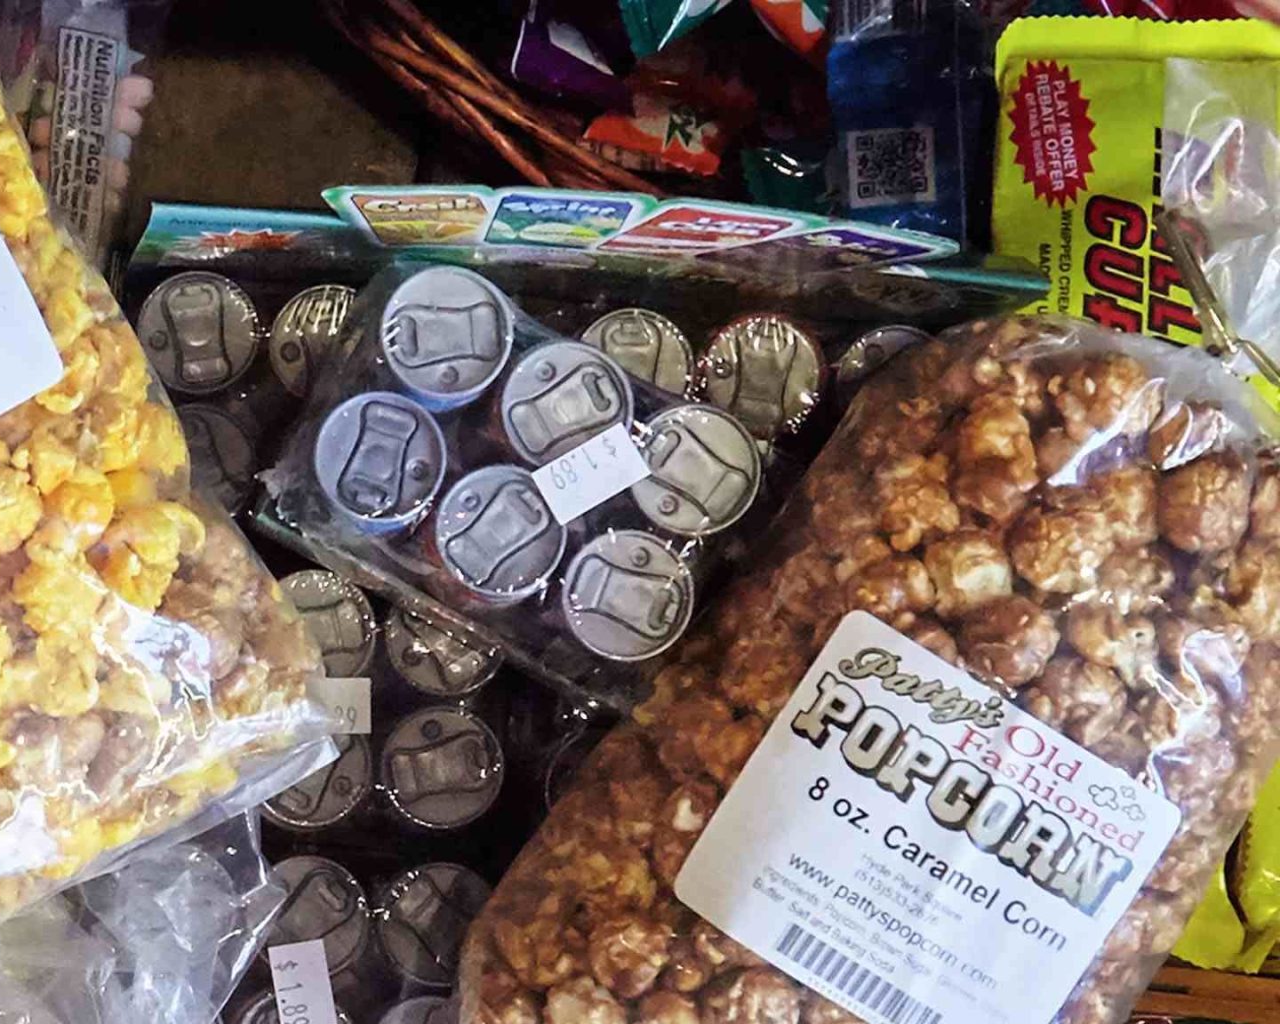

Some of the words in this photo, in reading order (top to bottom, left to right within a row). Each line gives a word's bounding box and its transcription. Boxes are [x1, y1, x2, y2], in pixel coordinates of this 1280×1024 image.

[90, 39, 115, 127] Nutrition
[1052, 79, 1070, 118] PLAY
[85, 131, 105, 187] Facts
[1035, 73, 1054, 133] REBATE
[1046, 137, 1065, 192] OFFER
[1059, 122, 1078, 180] MONEY
[1059, 208, 1073, 272] WHIPPED
[549, 446, 598, 490] 1.89
[839, 647, 1004, 729] Patty's
[1002, 724, 1083, 784] Old
[791, 672, 1132, 916] POPCORN
[951, 725, 1145, 852] Fashioned
[807, 775, 830, 801] 8
[832, 797, 870, 834] oz.
[882, 824, 1001, 910] Caramel
[1002, 899, 1067, 951] Corn
[861, 853, 892, 878] Hyde
[892, 872, 922, 897] Park
